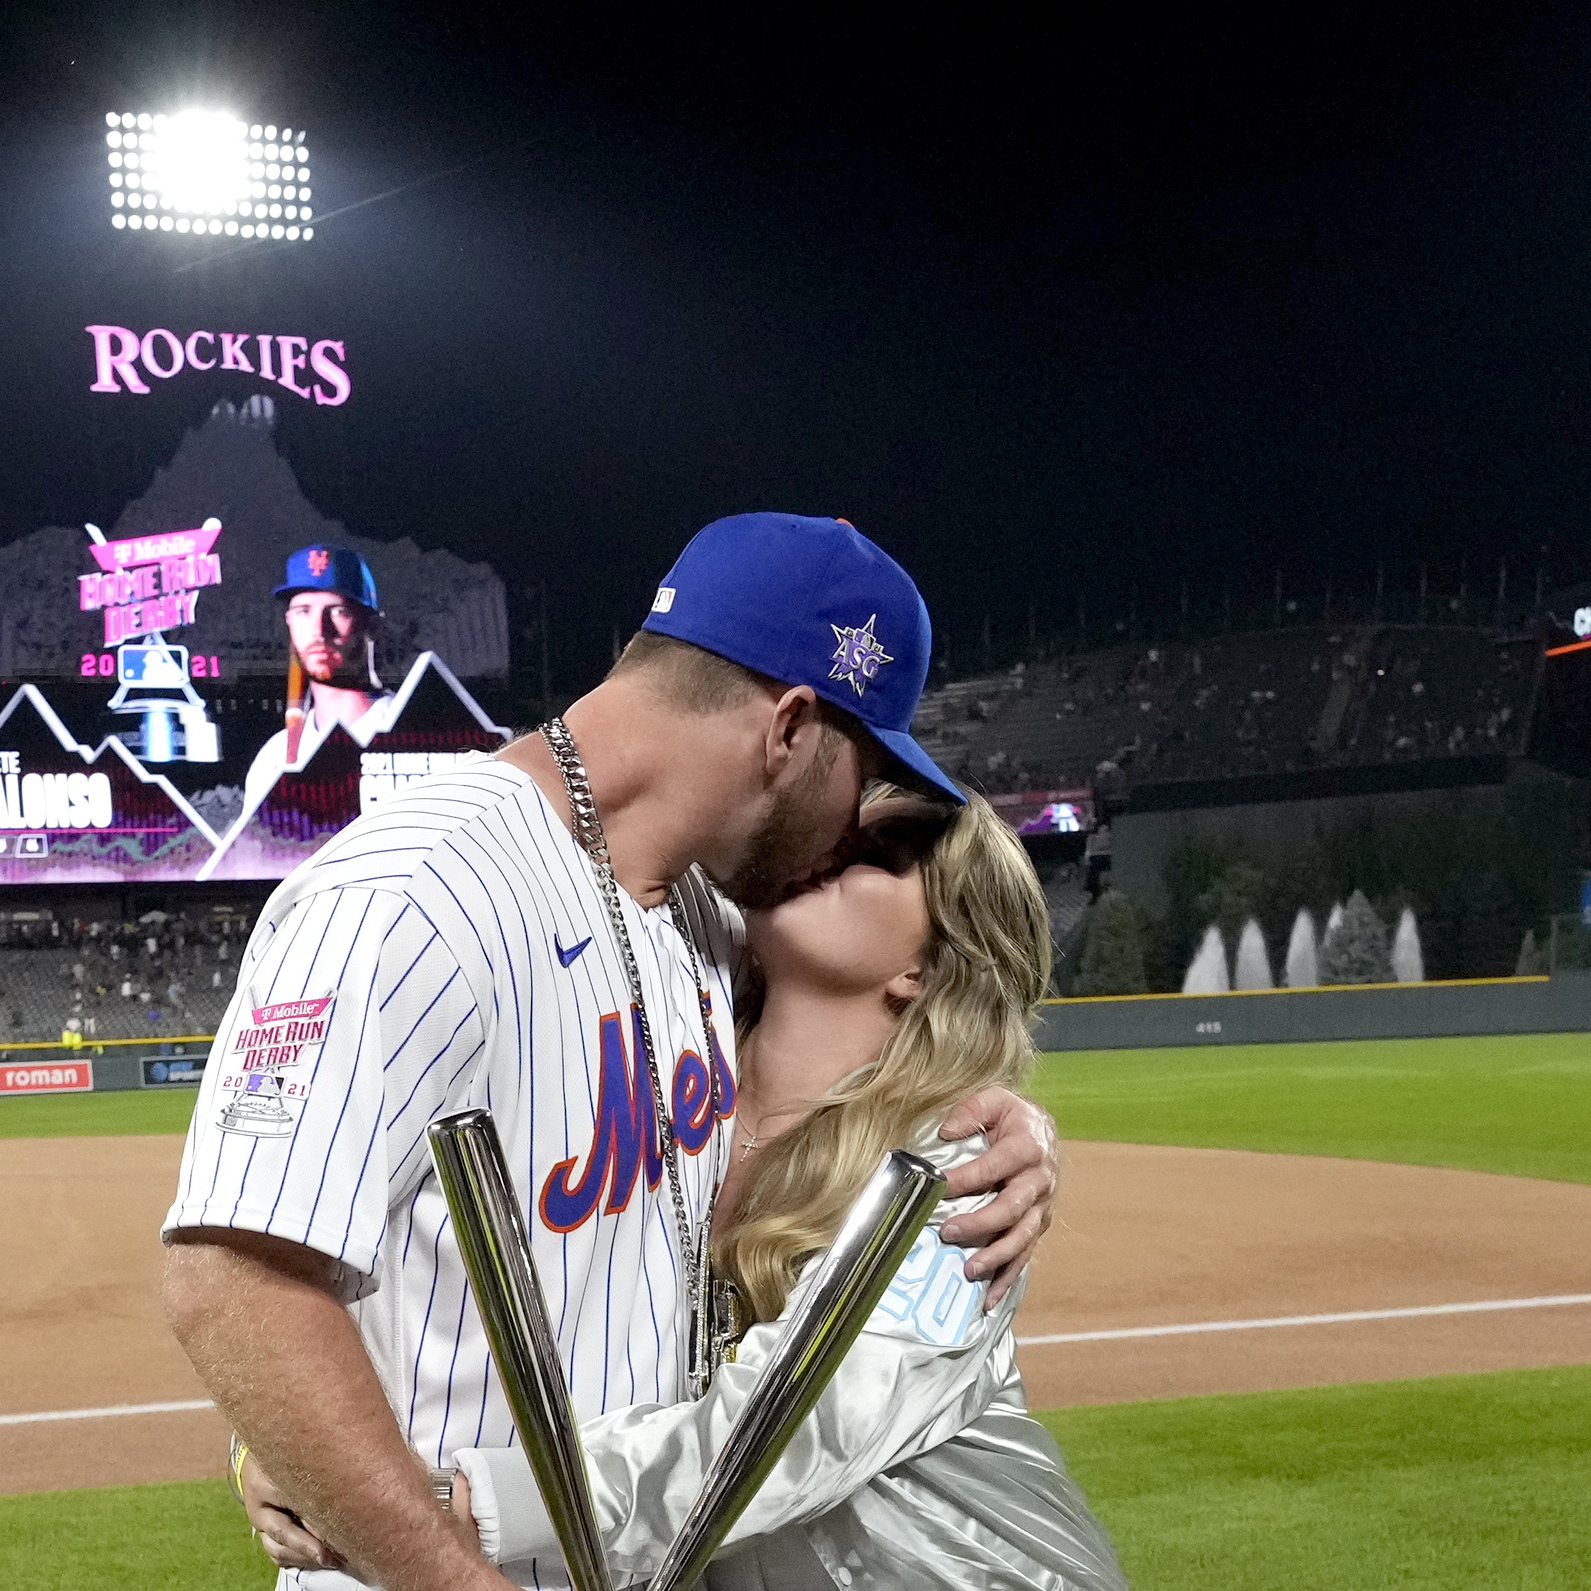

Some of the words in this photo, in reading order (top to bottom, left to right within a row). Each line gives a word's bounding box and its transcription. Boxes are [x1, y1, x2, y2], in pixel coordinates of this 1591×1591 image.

[84, 324, 352, 407] ROCKIES
[133, 535, 196, 562] Mobile
[78, 565, 160, 611] HOME
[160, 554, 222, 595] RUN
[103, 590, 199, 648] DERBY
[80, 653, 115, 677] 20
[190, 655, 221, 678] 21
[832, 638, 880, 679] ASG
[272, 1001, 315, 1019] Mobile
[236, 1025, 285, 1049] HOME
[286, 1020, 325, 1042] RUN
[243, 1043, 304, 1070] DERBY
[5, 1068, 78, 1087] roman
[223, 1076, 243, 1088] 20
[287, 1083, 306, 1097] 21
